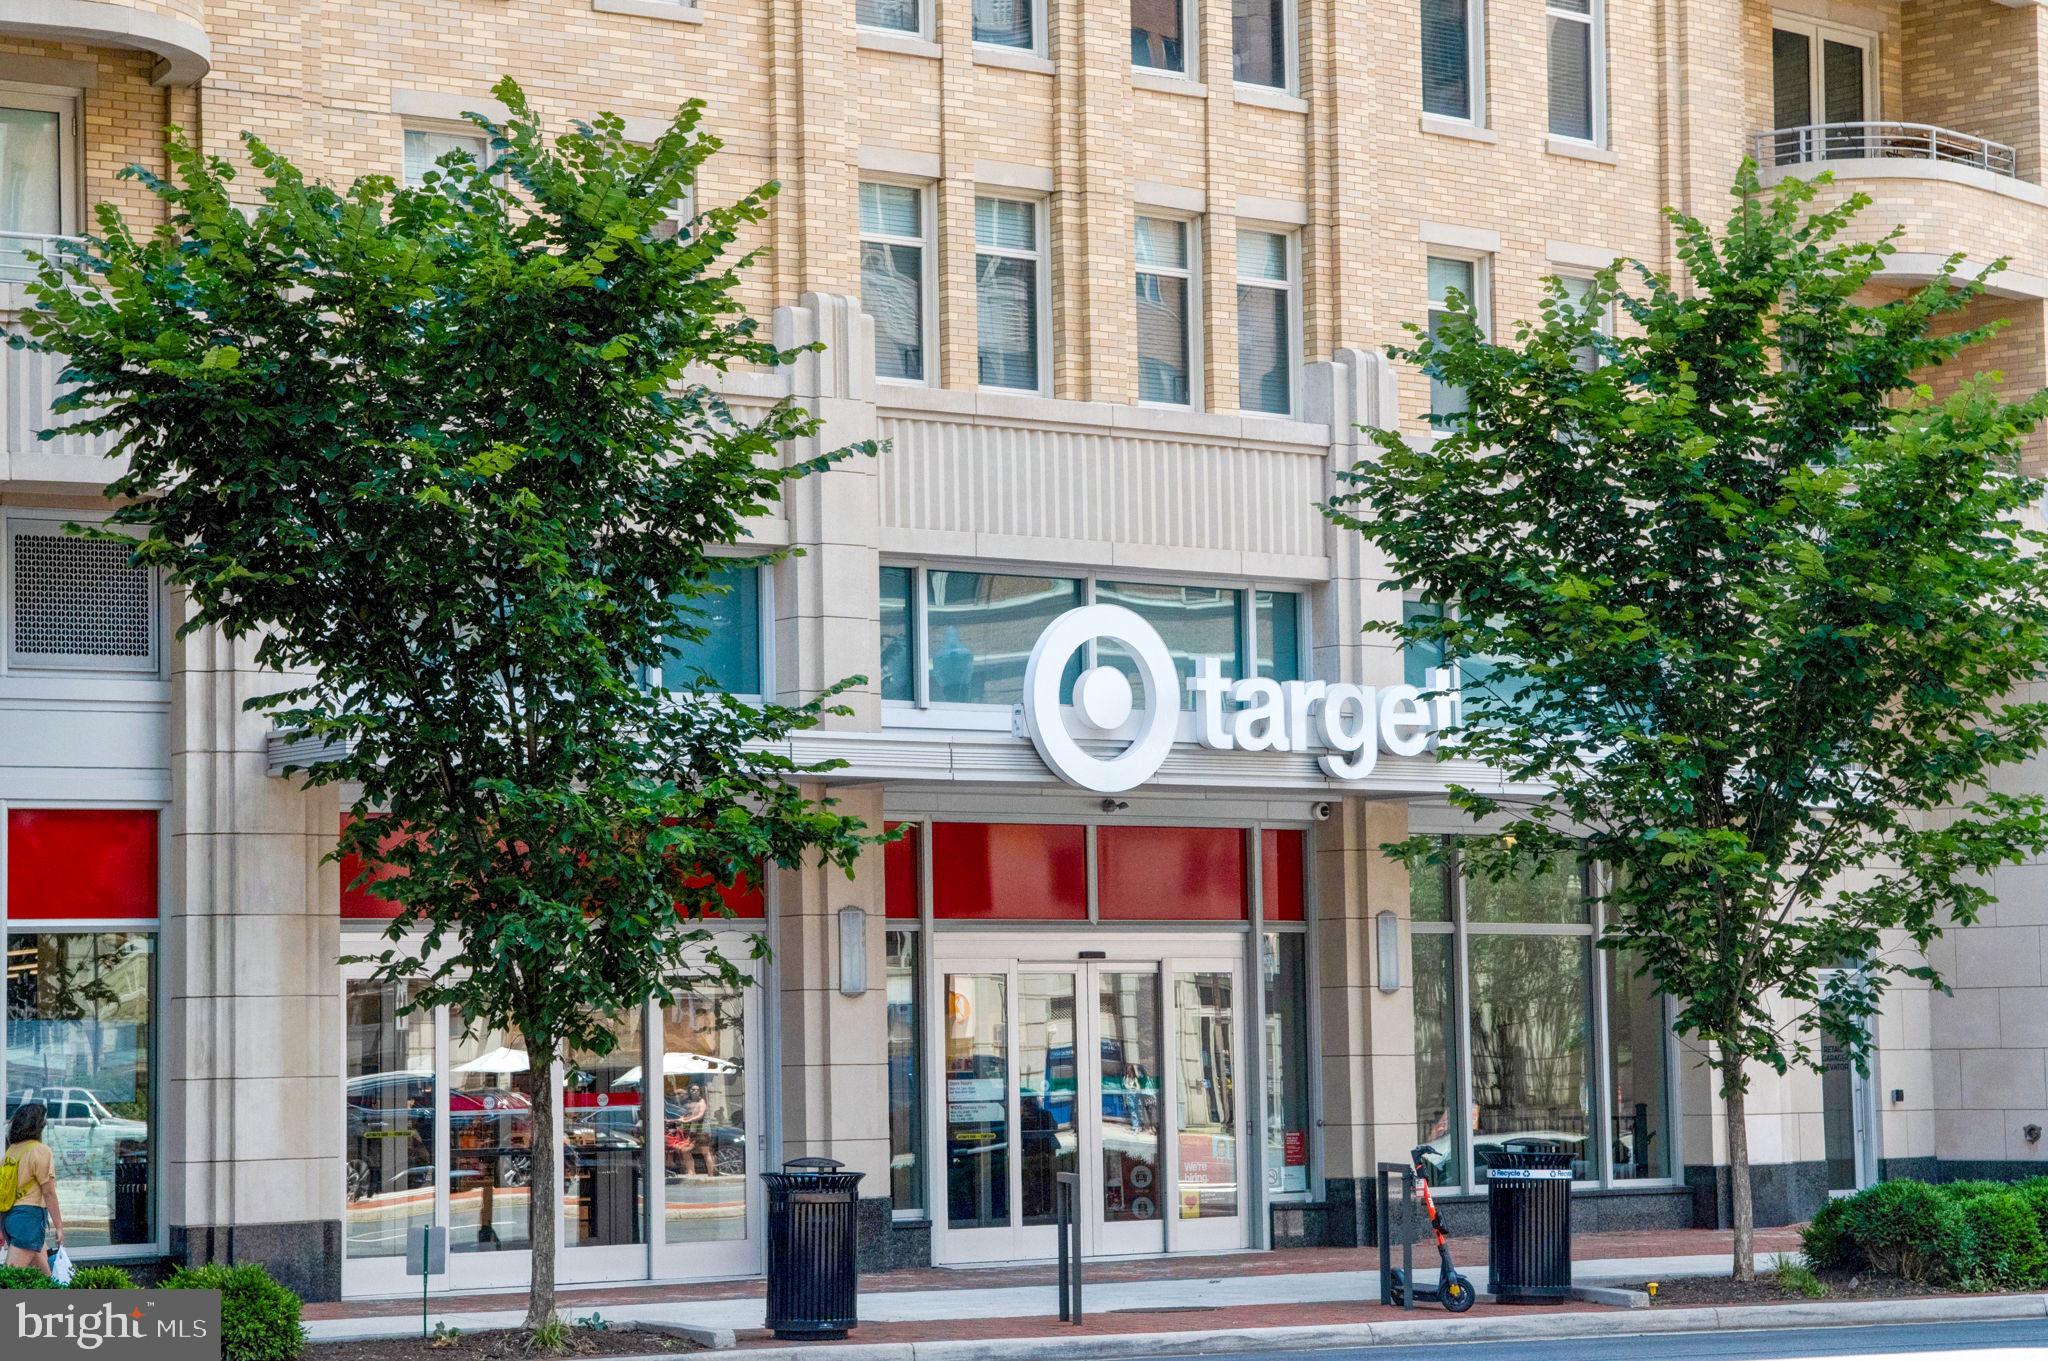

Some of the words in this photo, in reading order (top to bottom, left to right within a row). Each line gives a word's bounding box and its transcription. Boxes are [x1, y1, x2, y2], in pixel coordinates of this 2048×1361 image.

[1187, 655, 1462, 780] target
[1184, 1161, 1208, 1172] We're
[1496, 1169, 1521, 1178] Recycle
